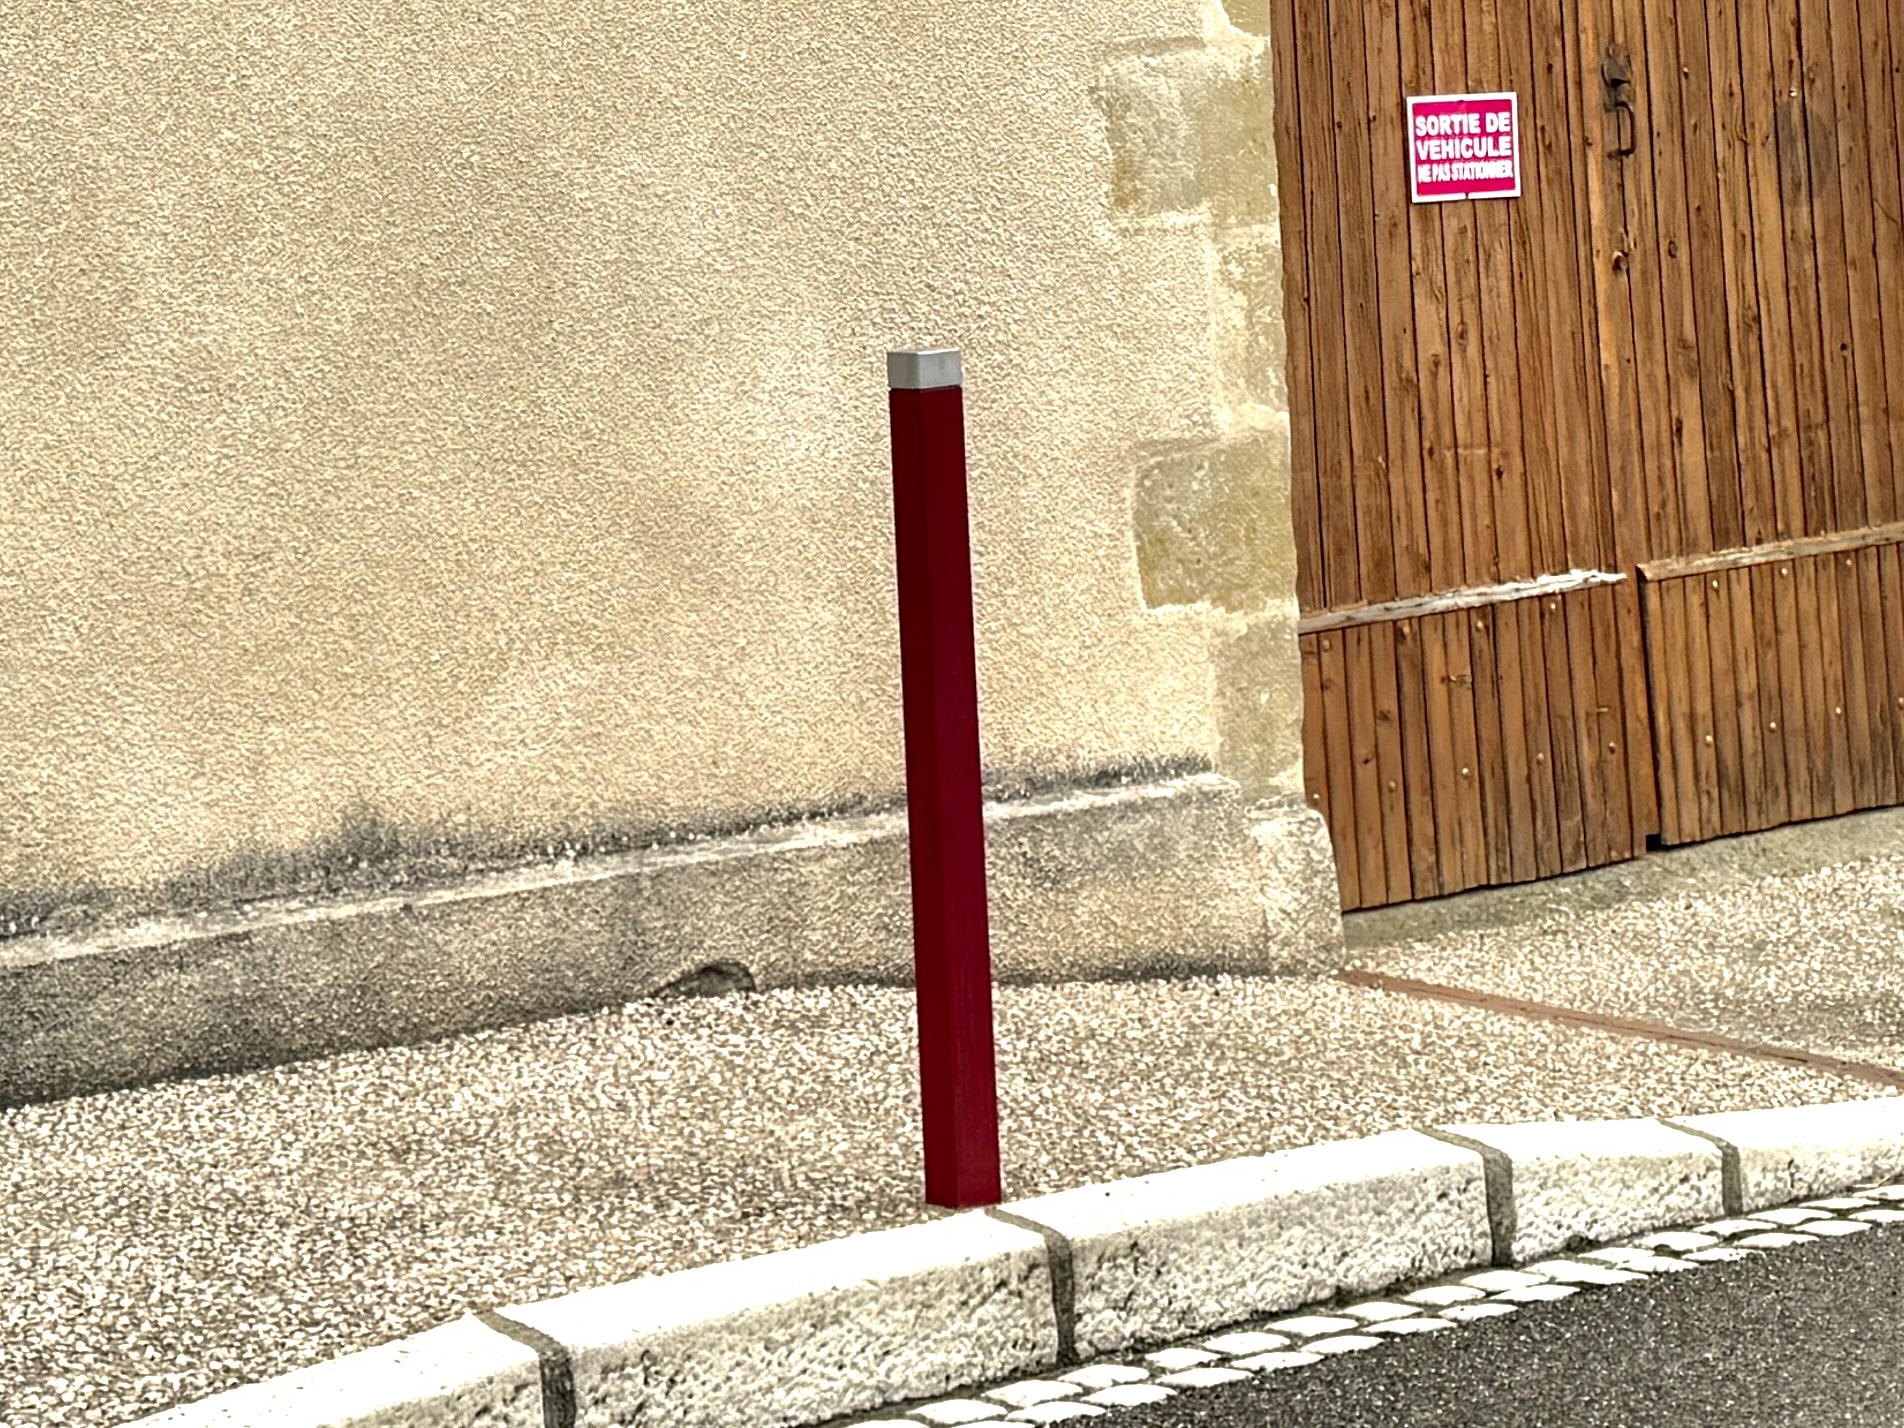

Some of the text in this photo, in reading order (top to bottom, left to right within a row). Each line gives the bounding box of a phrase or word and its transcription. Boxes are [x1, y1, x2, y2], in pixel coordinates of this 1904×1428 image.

[1415, 112, 1511, 136] SORTIE DE
[1416, 136, 1512, 160] VEHICULE
[1417, 160, 1513, 183] NE PAS STATIONNER
